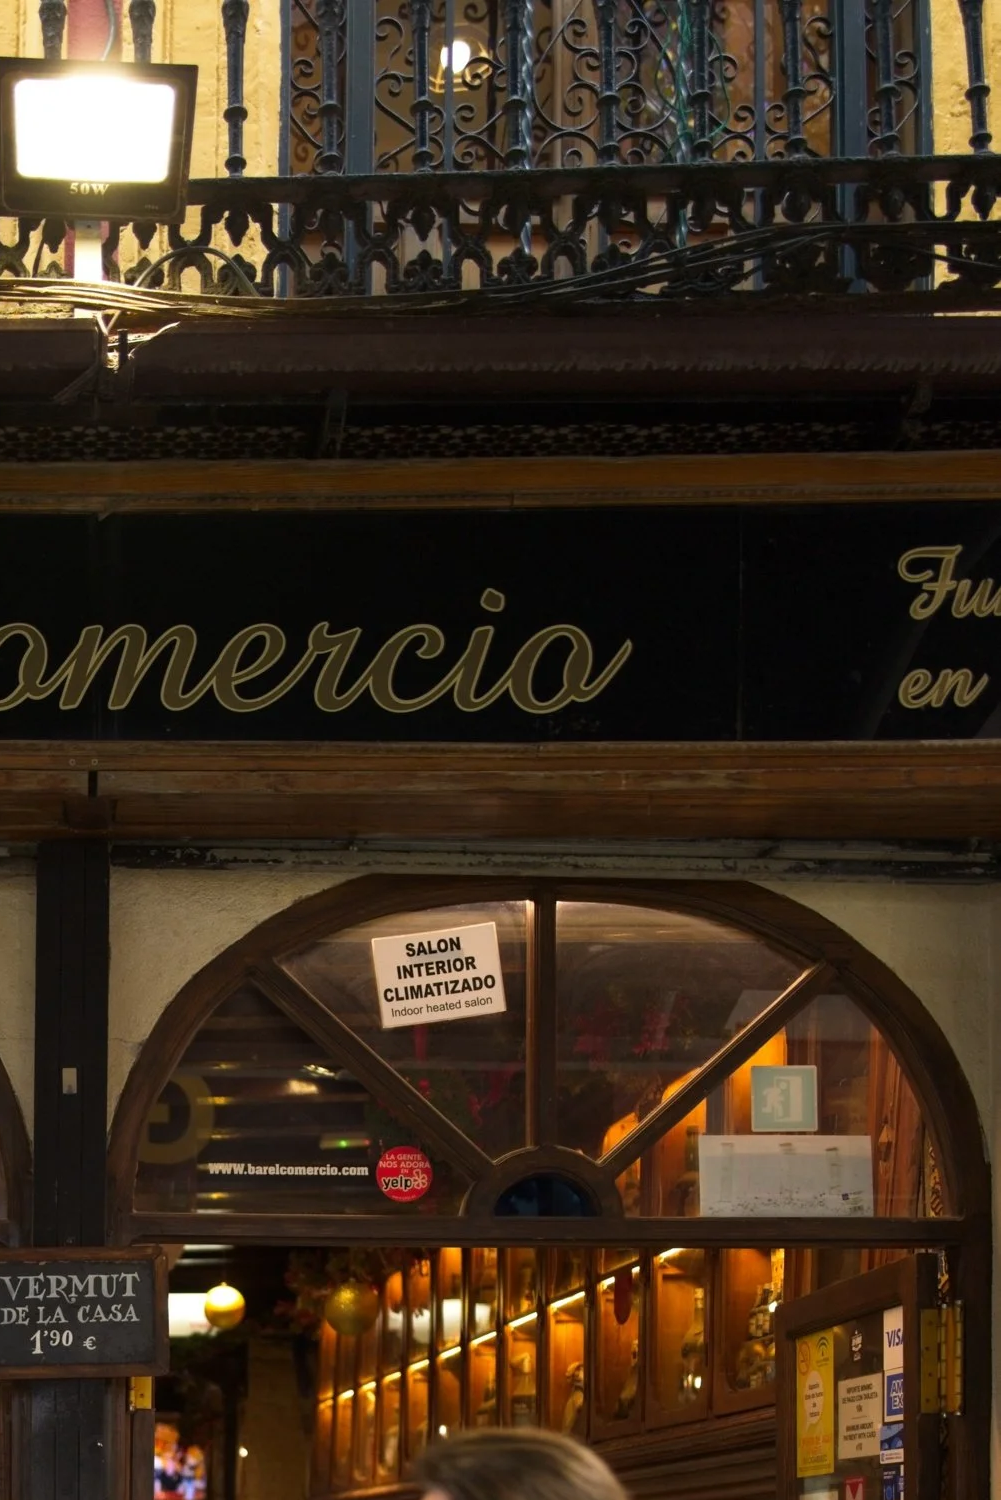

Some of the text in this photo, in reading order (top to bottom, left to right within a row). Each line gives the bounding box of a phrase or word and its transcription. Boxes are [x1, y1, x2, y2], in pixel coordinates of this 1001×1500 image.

[69, 182, 109, 195] 50W
[899, 668, 989, 709] en
[405, 936, 462, 957] SALON
[396, 956, 477, 980] INTERIOR
[383, 974, 496, 1003] CLIMATIZADO
[391, 996, 493, 1018] Indoor heated salon
[382, 1175, 413, 1192] yelp
[0, 1272, 141, 1304] VERMUT
[0, 1304, 140, 1326] DE LA CASA
[82, 1336, 96, 1350] €
